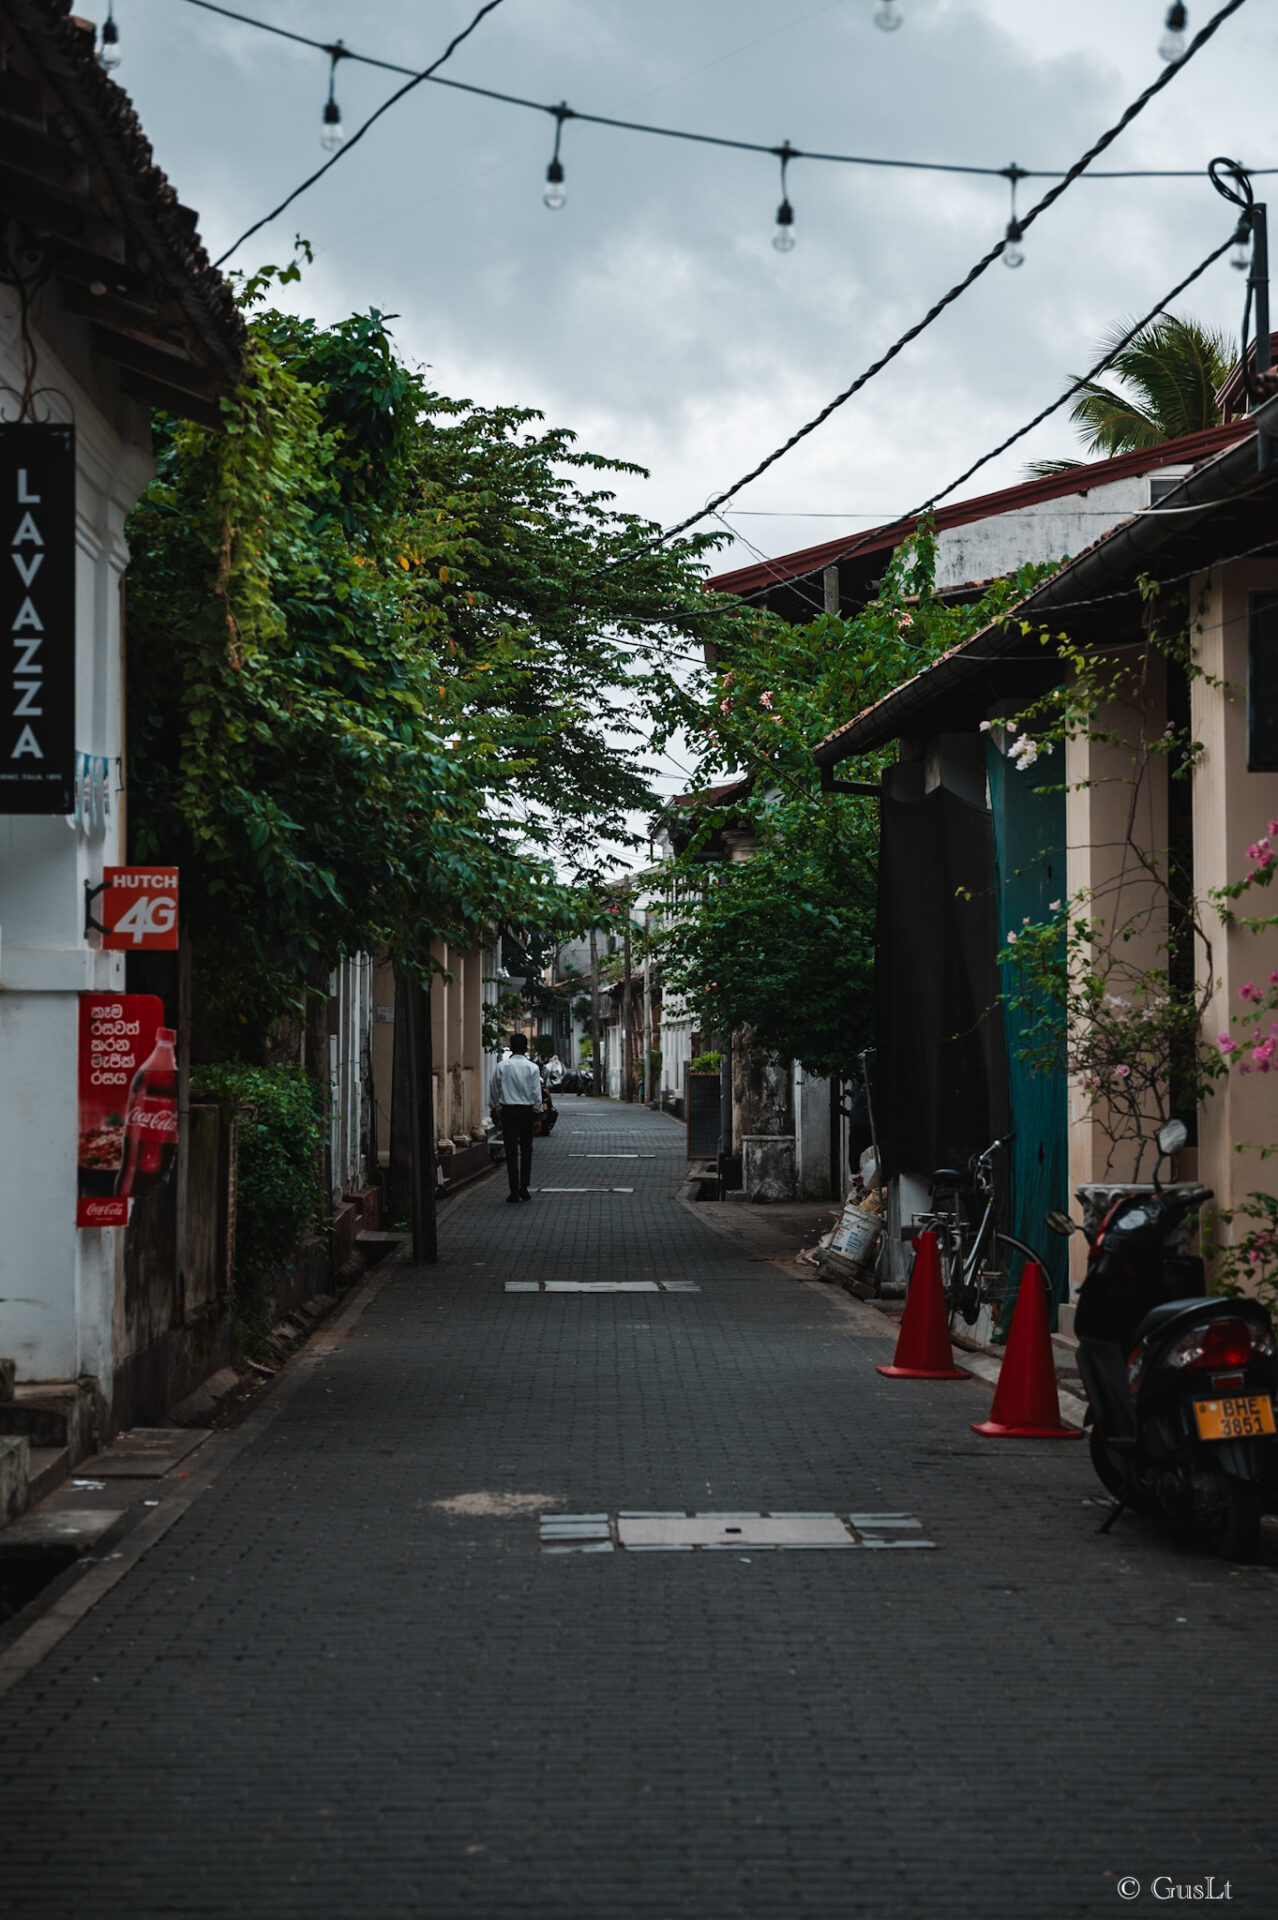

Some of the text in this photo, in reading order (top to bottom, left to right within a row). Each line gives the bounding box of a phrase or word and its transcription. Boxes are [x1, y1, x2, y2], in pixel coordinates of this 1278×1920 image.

[11, 469, 45, 758] LAVAZZA
[113, 875, 177, 888] HUTCH
[113, 896, 176, 944] 4G
[91, 1037, 130, 1052] කරන
[90, 1070, 127, 1085] රසය
[1223, 1397, 1260, 1417] BHE
[1220, 1416, 1264, 1435] 3851
